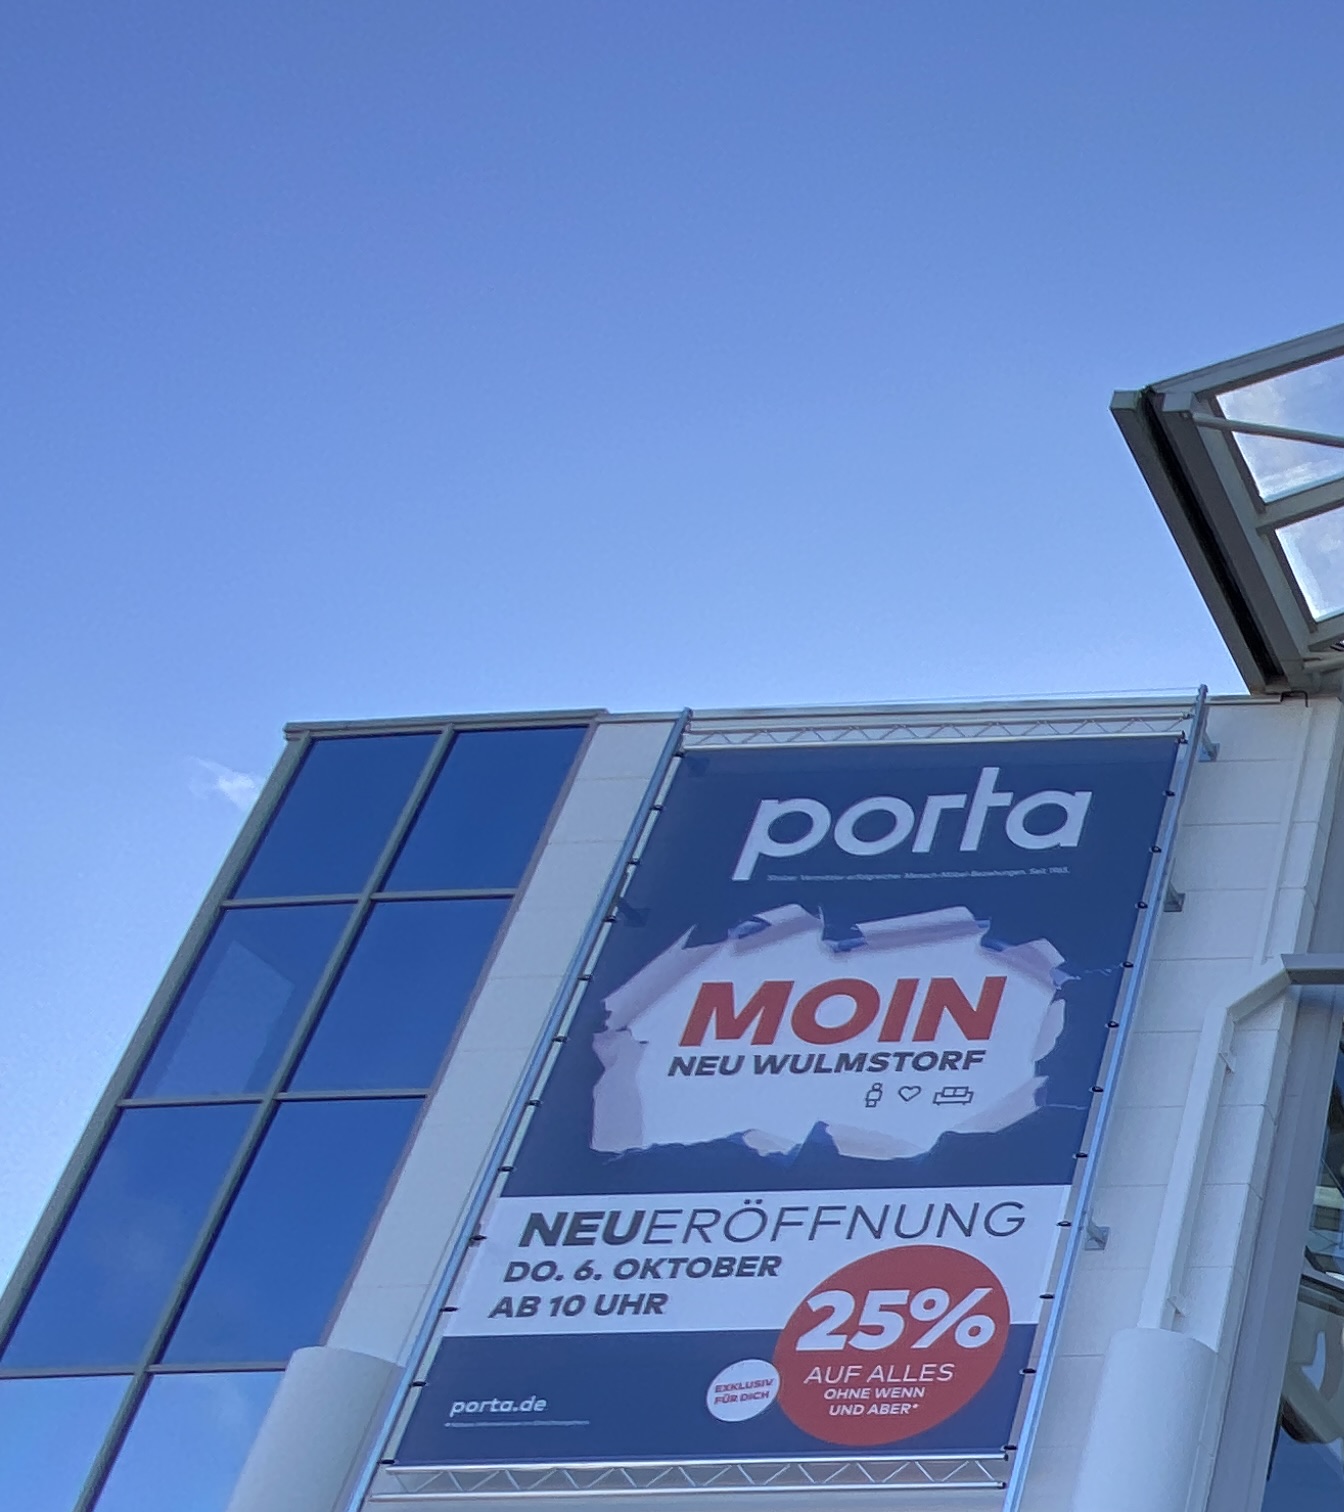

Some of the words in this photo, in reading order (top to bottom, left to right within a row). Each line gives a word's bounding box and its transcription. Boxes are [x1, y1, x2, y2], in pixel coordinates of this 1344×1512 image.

[731, 766, 1093, 881] porta
[679, 976, 1007, 1048] MOIN
[668, 1054, 749, 1077] NEU
[752, 1049, 986, 1075] WULMSTORF
[518, 1199, 1025, 1248] NEUERÖFFNUNG
[503, 1261, 564, 1283] DO.
[574, 1260, 603, 1281] 6.
[613, 1255, 783, 1280] OKTOBER
[488, 1296, 544, 1319] AB
[549, 1295, 587, 1318] 10
[593, 1293, 669, 1317] UHR
[795, 1287, 996, 1352] 25%
[714, 1378, 774, 1393] EXKLUSIV
[803, 1365, 863, 1384] AUF
[867, 1363, 955, 1383] ALLES
[449, 1395, 547, 1417] porta.de
[713, 1391, 739, 1405] FÜR
[740, 1390, 770, 1402] DICH
[824, 1388, 870, 1400] OHNE
[875, 1387, 925, 1399] WENN
[829, 1404, 865, 1415] UND
